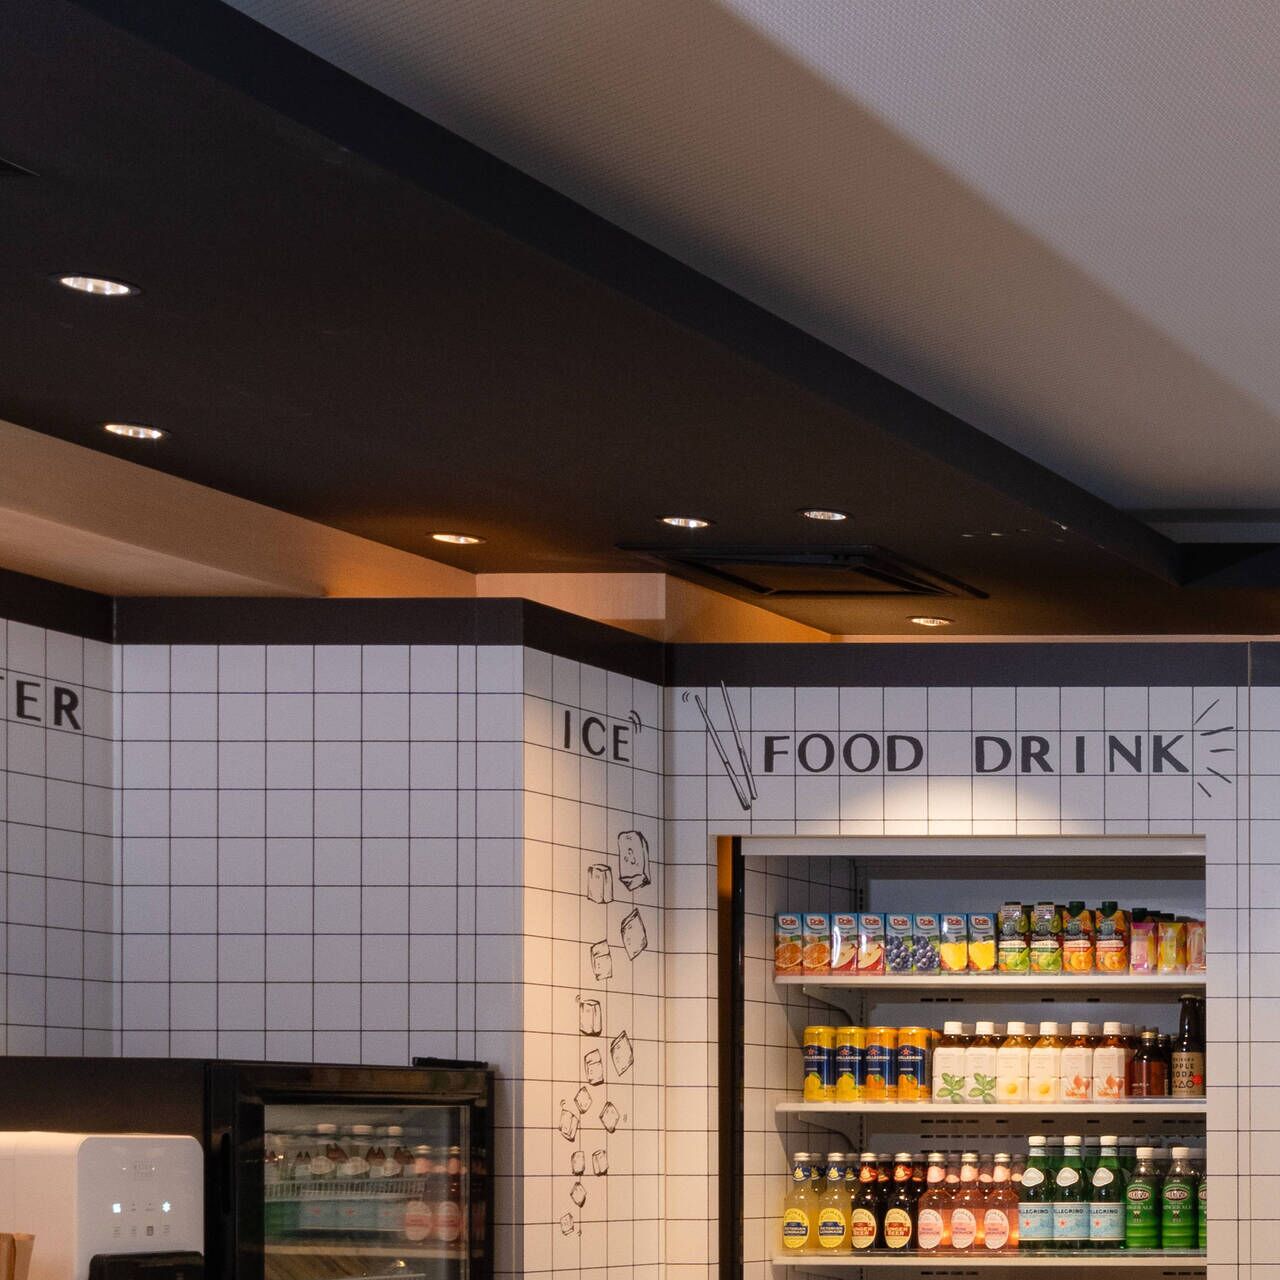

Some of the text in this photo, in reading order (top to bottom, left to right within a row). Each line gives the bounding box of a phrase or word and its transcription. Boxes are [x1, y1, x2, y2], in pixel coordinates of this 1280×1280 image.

[0, 680, 82, 731] ER
[563, 709, 631, 763] ICE
[764, 733, 1190, 774] FOOD DRINK
